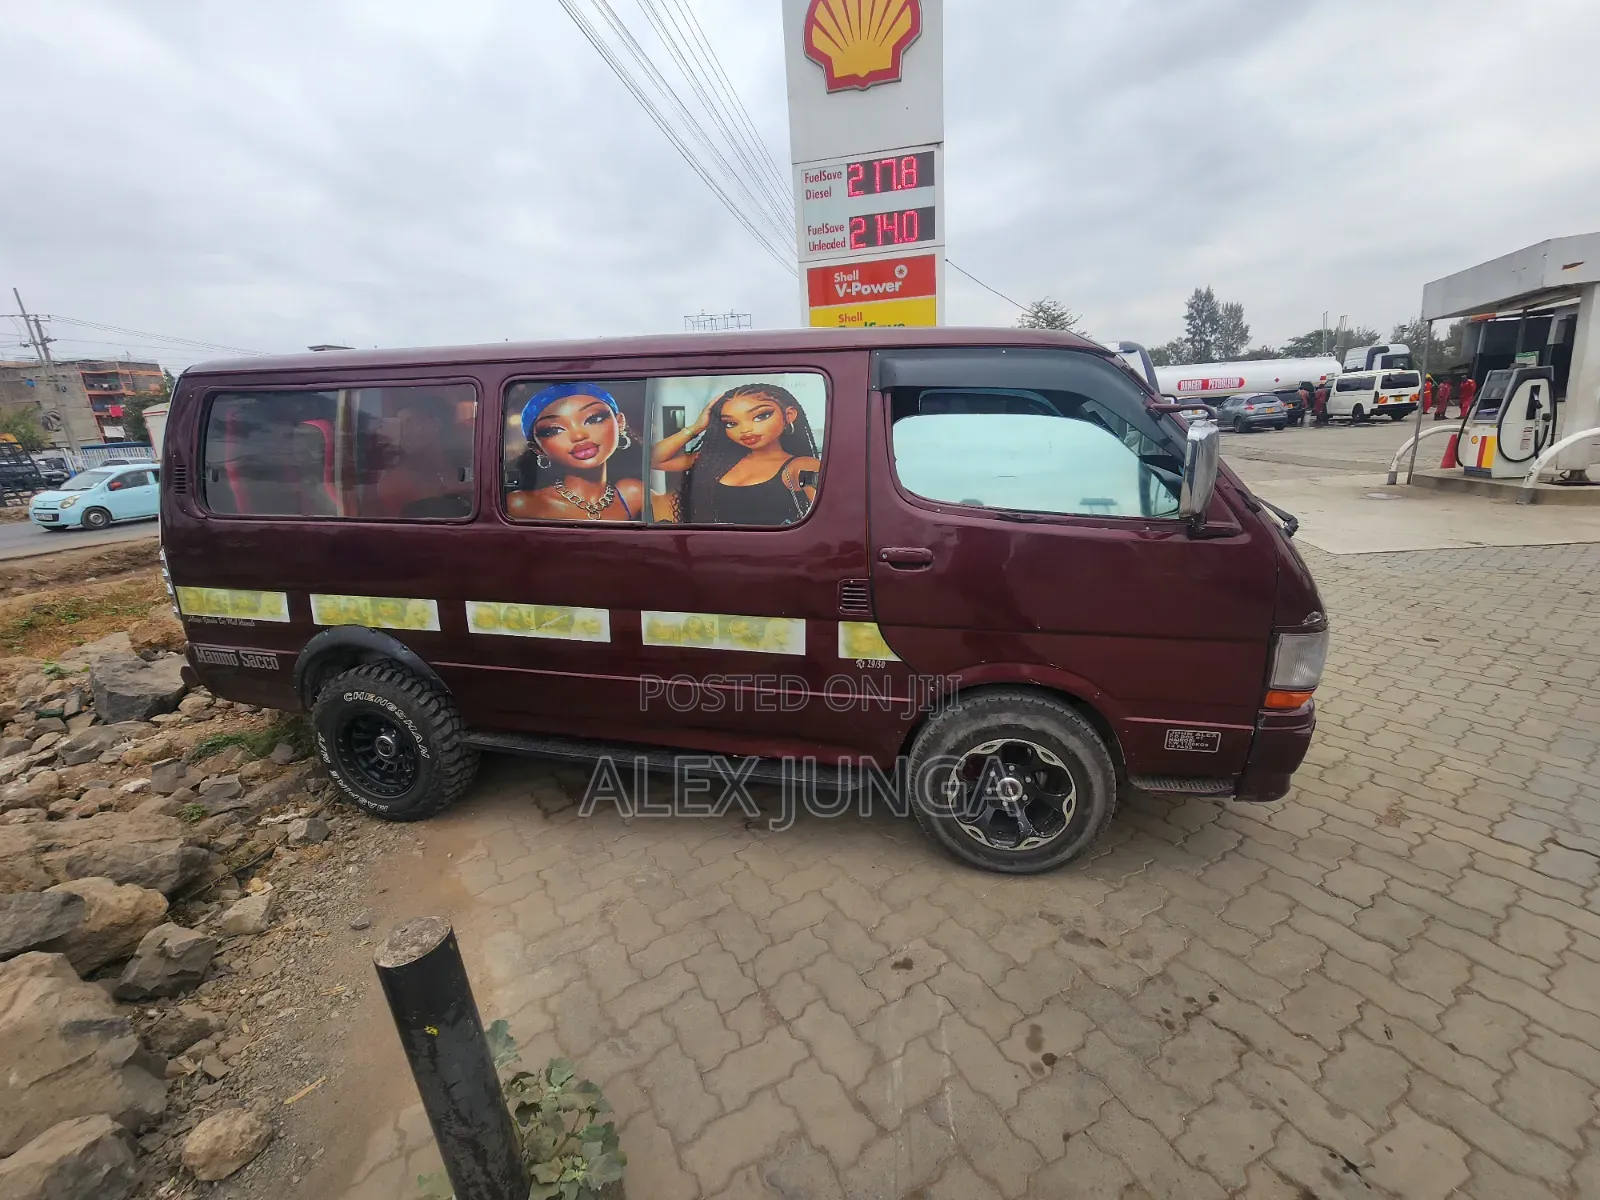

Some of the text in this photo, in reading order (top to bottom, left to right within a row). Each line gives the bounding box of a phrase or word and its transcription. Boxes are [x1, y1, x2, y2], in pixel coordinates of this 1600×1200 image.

[804, 170, 843, 184] FuelSave
[848, 155, 918, 197] 217.8
[805, 186, 832, 200] Diesel
[807, 223, 845, 236] FuelSave
[808, 239, 846, 252] Unleaded
[833, 269, 860, 283] Shell
[834, 280, 903, 298] V-Power
[838, 311, 863, 323] Shell
[1180, 377, 1241, 391] DANGER PETROLEUM
[239, 650, 280, 670] Sacco
[343, 691, 431, 760] CHENGSHAN
